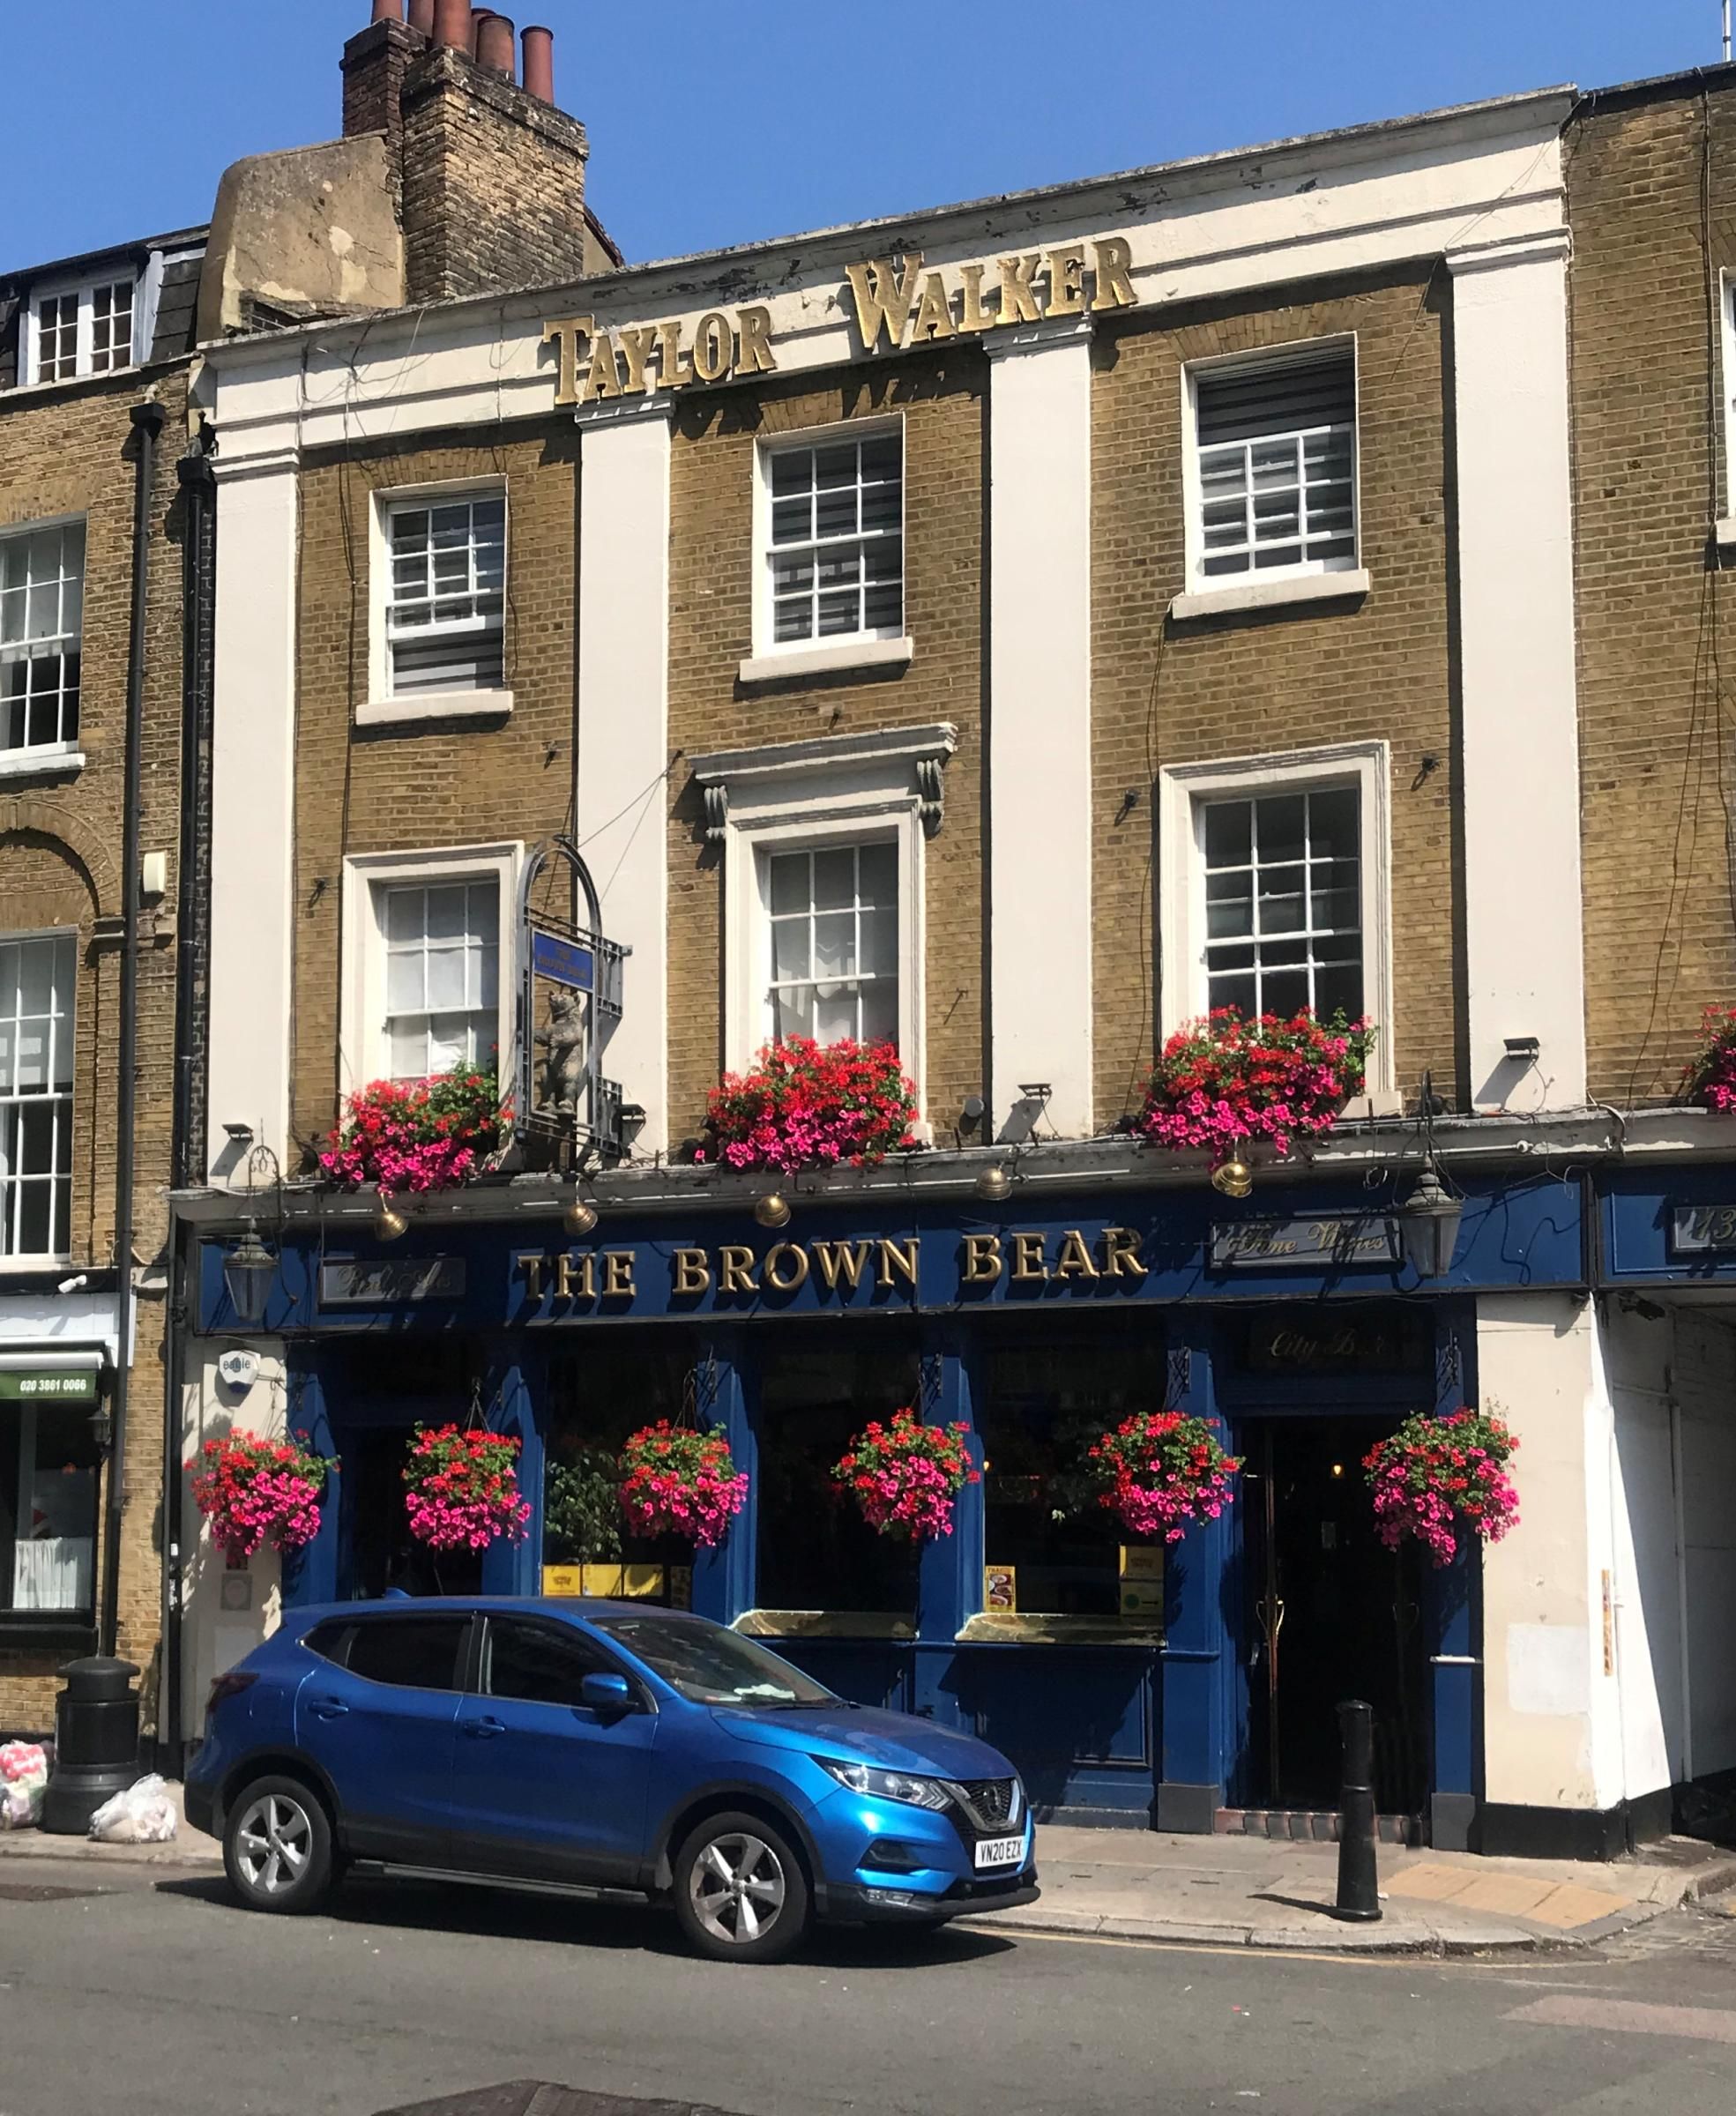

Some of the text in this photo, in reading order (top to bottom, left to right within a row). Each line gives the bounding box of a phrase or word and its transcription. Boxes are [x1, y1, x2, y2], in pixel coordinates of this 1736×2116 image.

[543, 236, 1138, 405] TAYLOR WALKER
[518, 1226, 1149, 1301] THE BROWN BEAR
[19, 1380, 37, 1391] 020
[1006, 1840, 1021, 1859] EZX
